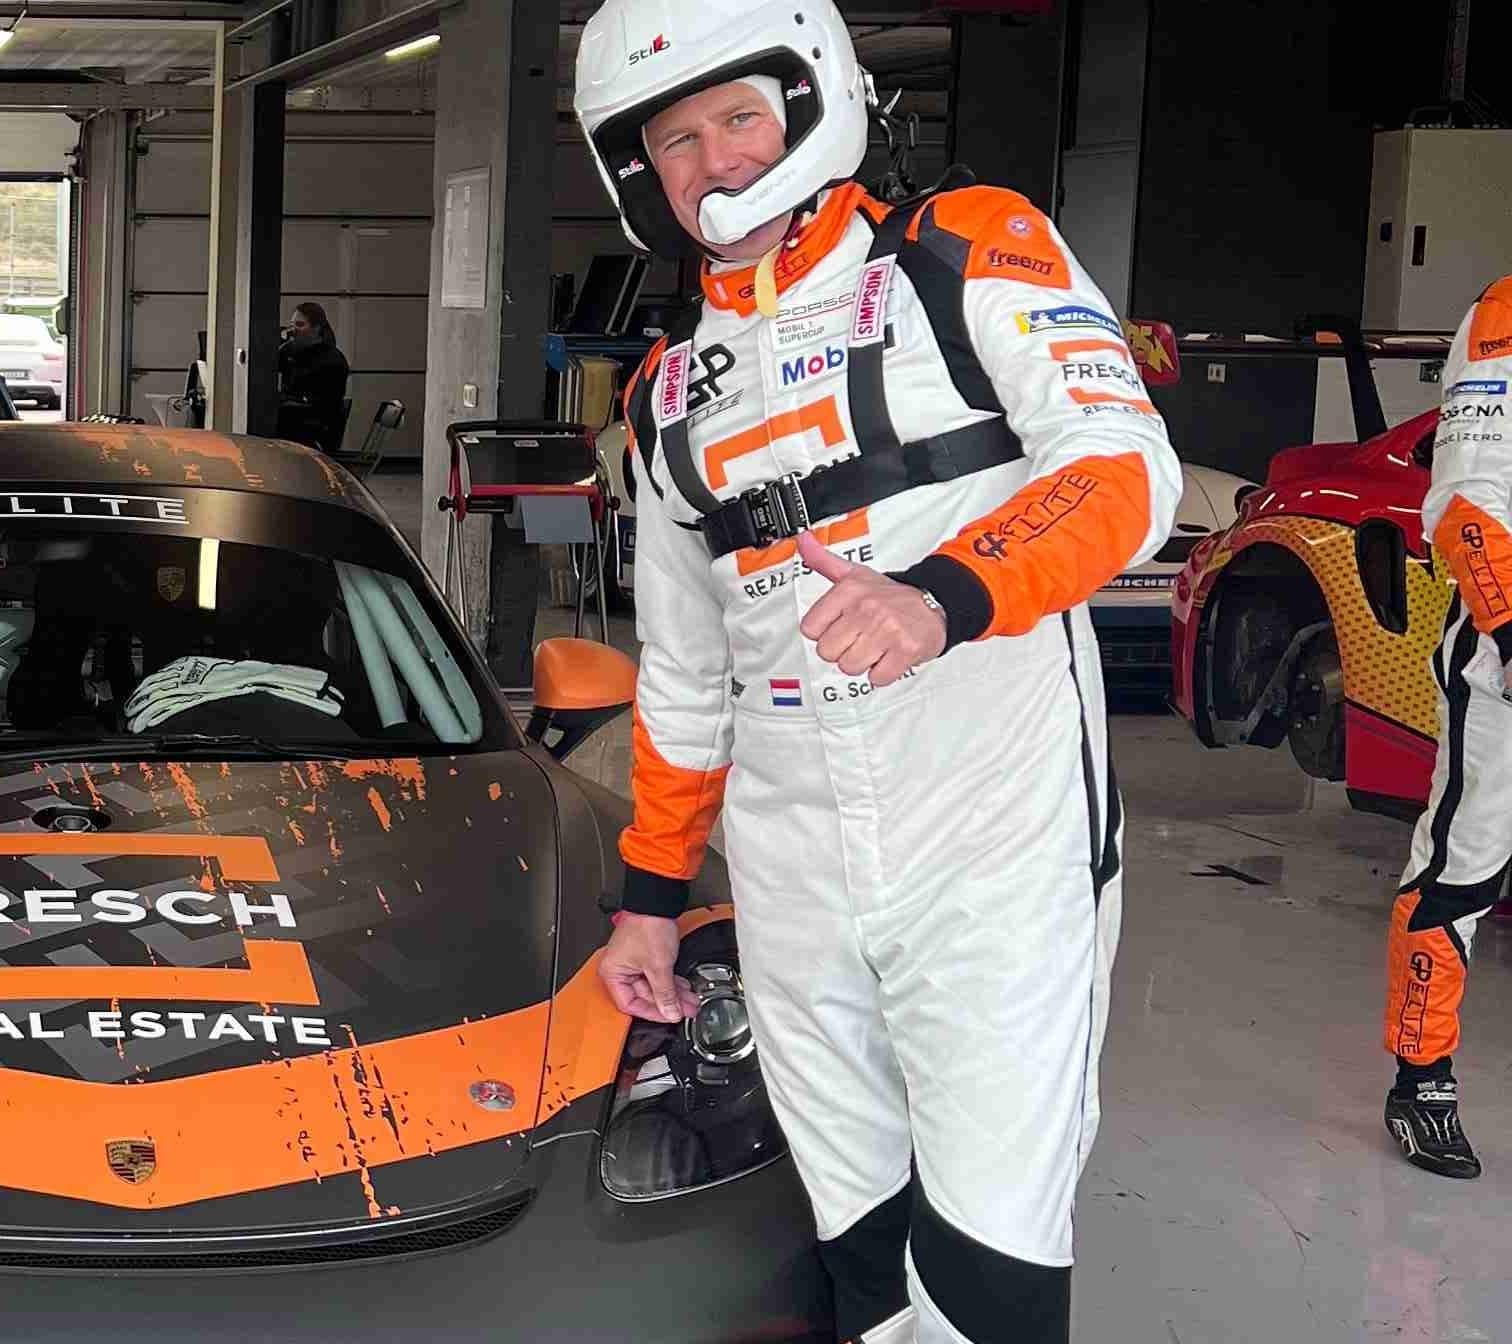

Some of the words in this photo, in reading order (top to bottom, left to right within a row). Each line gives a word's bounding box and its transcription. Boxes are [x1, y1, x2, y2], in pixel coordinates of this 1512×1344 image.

[988, 238, 1055, 275] freem
[855, 268, 884, 337] SIMPSON
[662, 353, 682, 416] SIMPSON
[781, 346, 845, 386] Mob
[823, 686, 844, 702] G.
[88, 1011, 332, 1050] ESTATE
